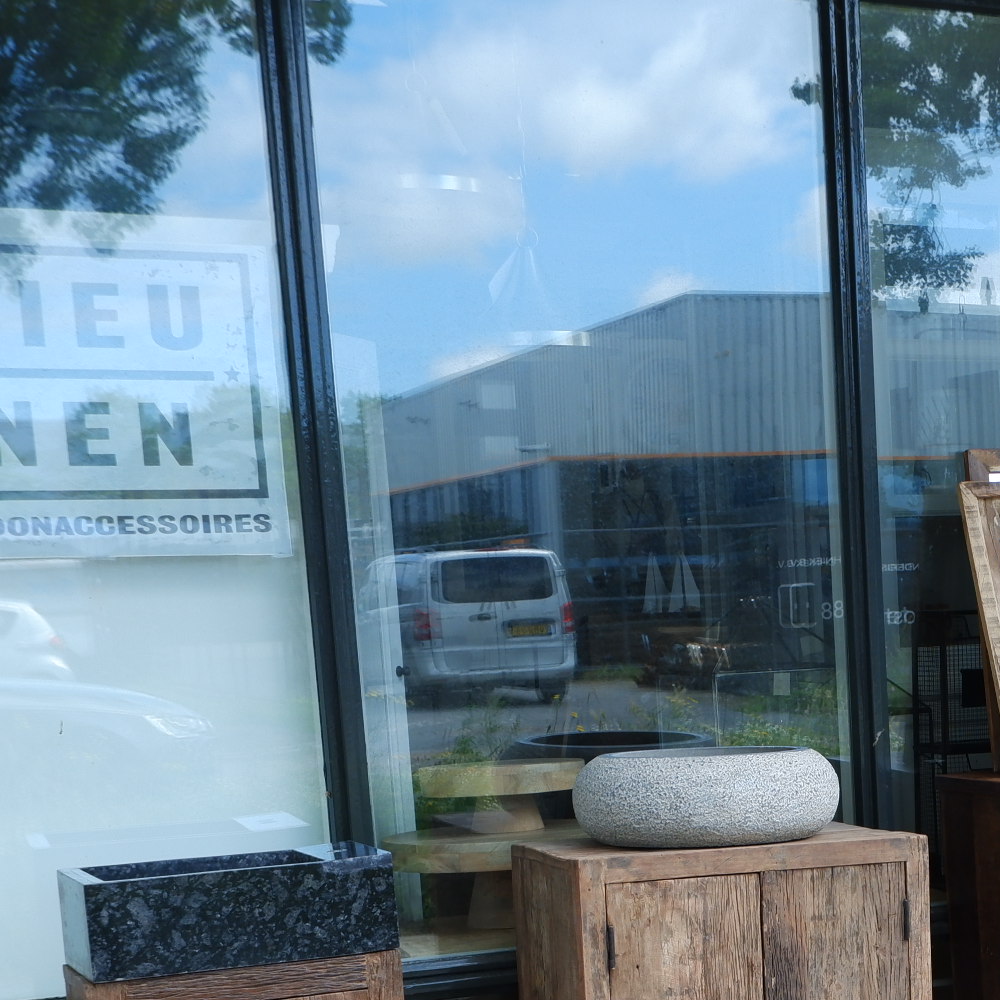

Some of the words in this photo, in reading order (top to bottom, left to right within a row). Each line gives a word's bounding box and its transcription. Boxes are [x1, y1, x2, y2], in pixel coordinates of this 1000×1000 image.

[18, 280, 203, 351] IEU
[0, 401, 194, 467] NEN
[0, 513, 273, 537] ONACCESSOIRES
